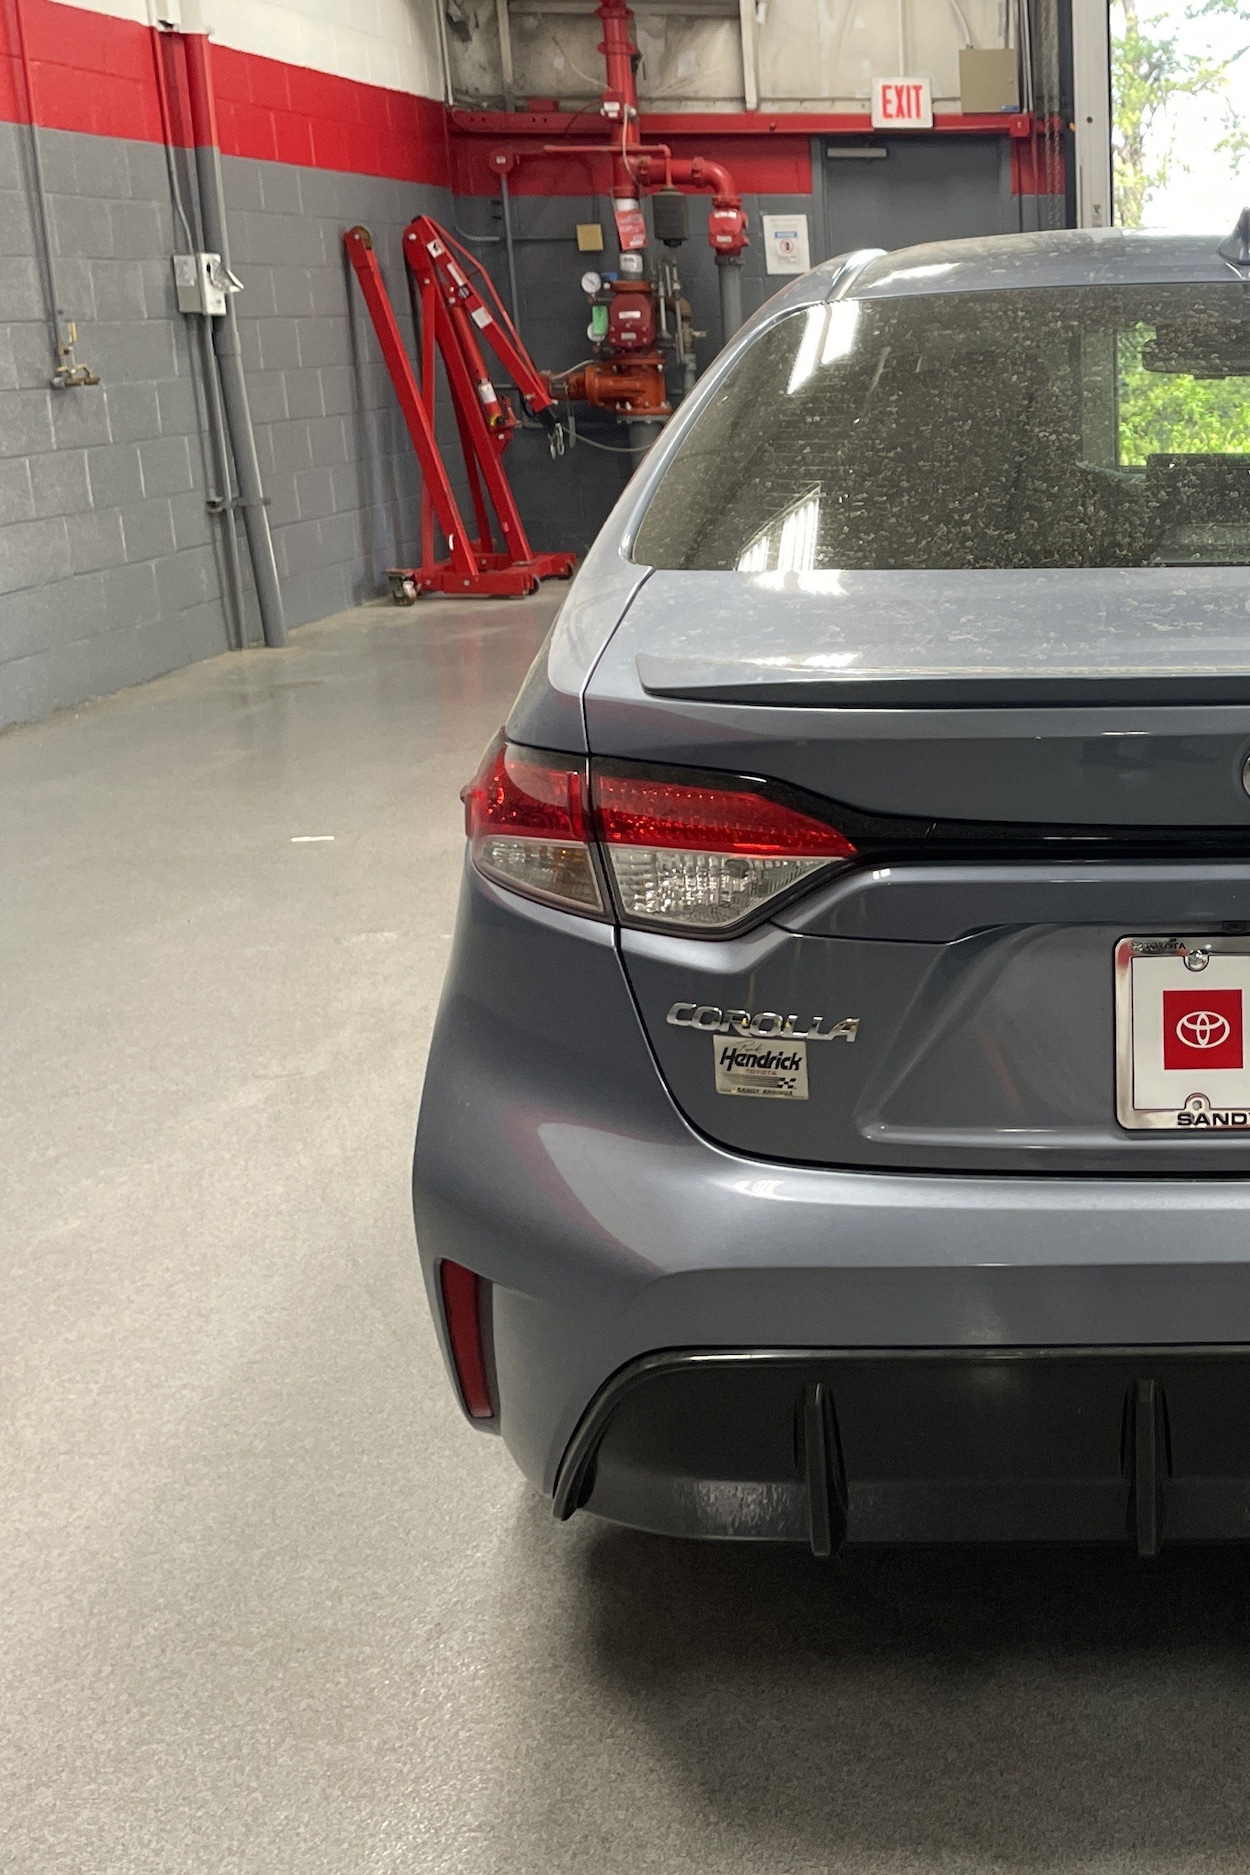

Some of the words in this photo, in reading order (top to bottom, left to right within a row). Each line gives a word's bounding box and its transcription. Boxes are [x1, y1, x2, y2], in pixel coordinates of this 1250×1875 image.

[882, 84, 923, 119] EXIT
[1145, 941, 1186, 951] TOYOTA
[666, 1002, 860, 1042] COROLLA
[720, 1047, 803, 1072] Hendrick
[746, 1068, 777, 1076] TOYOTA
